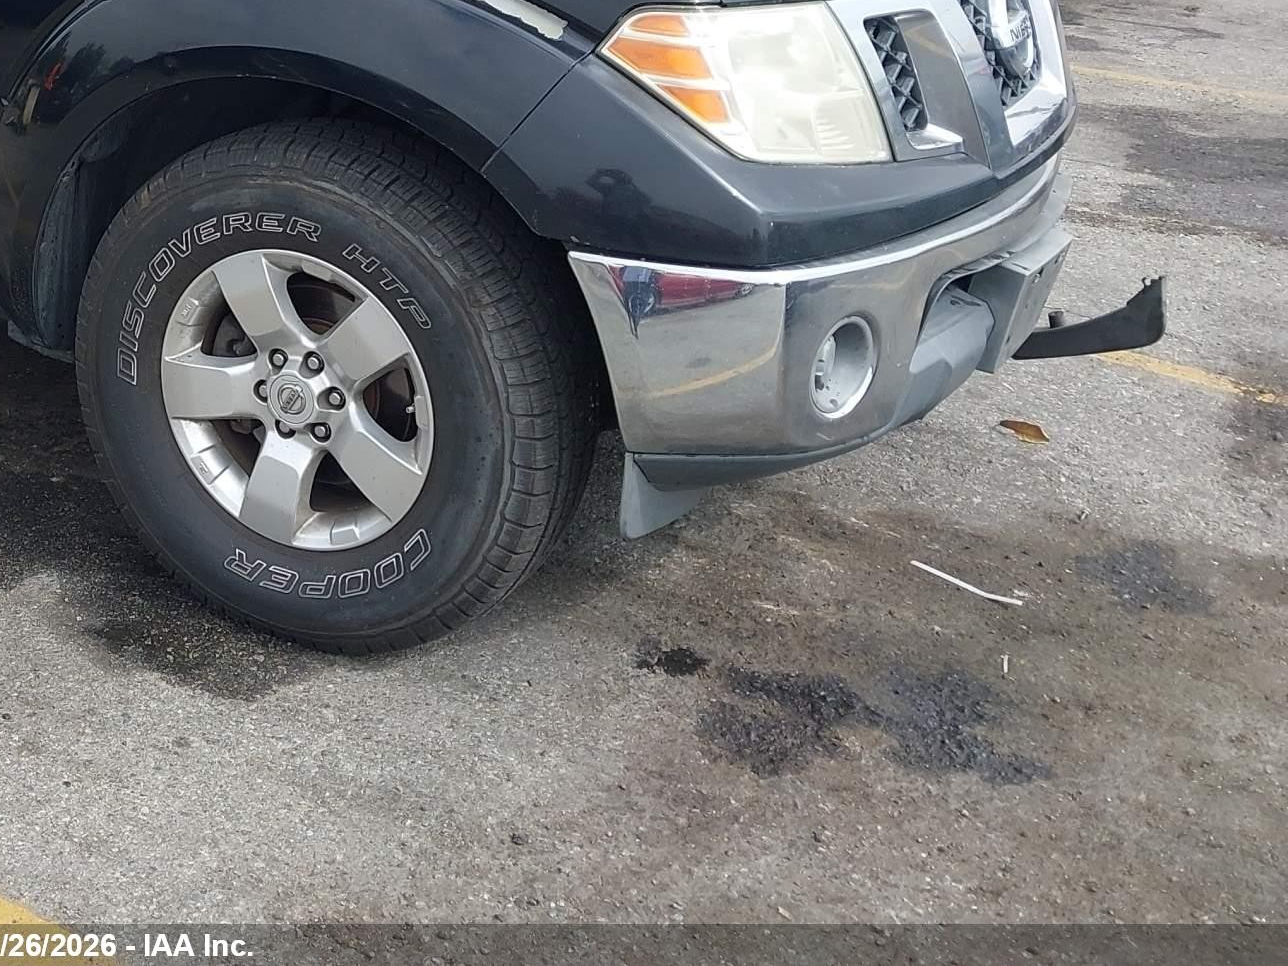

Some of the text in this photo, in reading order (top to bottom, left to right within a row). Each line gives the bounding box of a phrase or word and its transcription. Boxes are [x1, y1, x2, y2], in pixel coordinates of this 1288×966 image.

[116, 212, 432, 385] DISCOVERER HTP
[223, 528, 432, 599] COOPER
